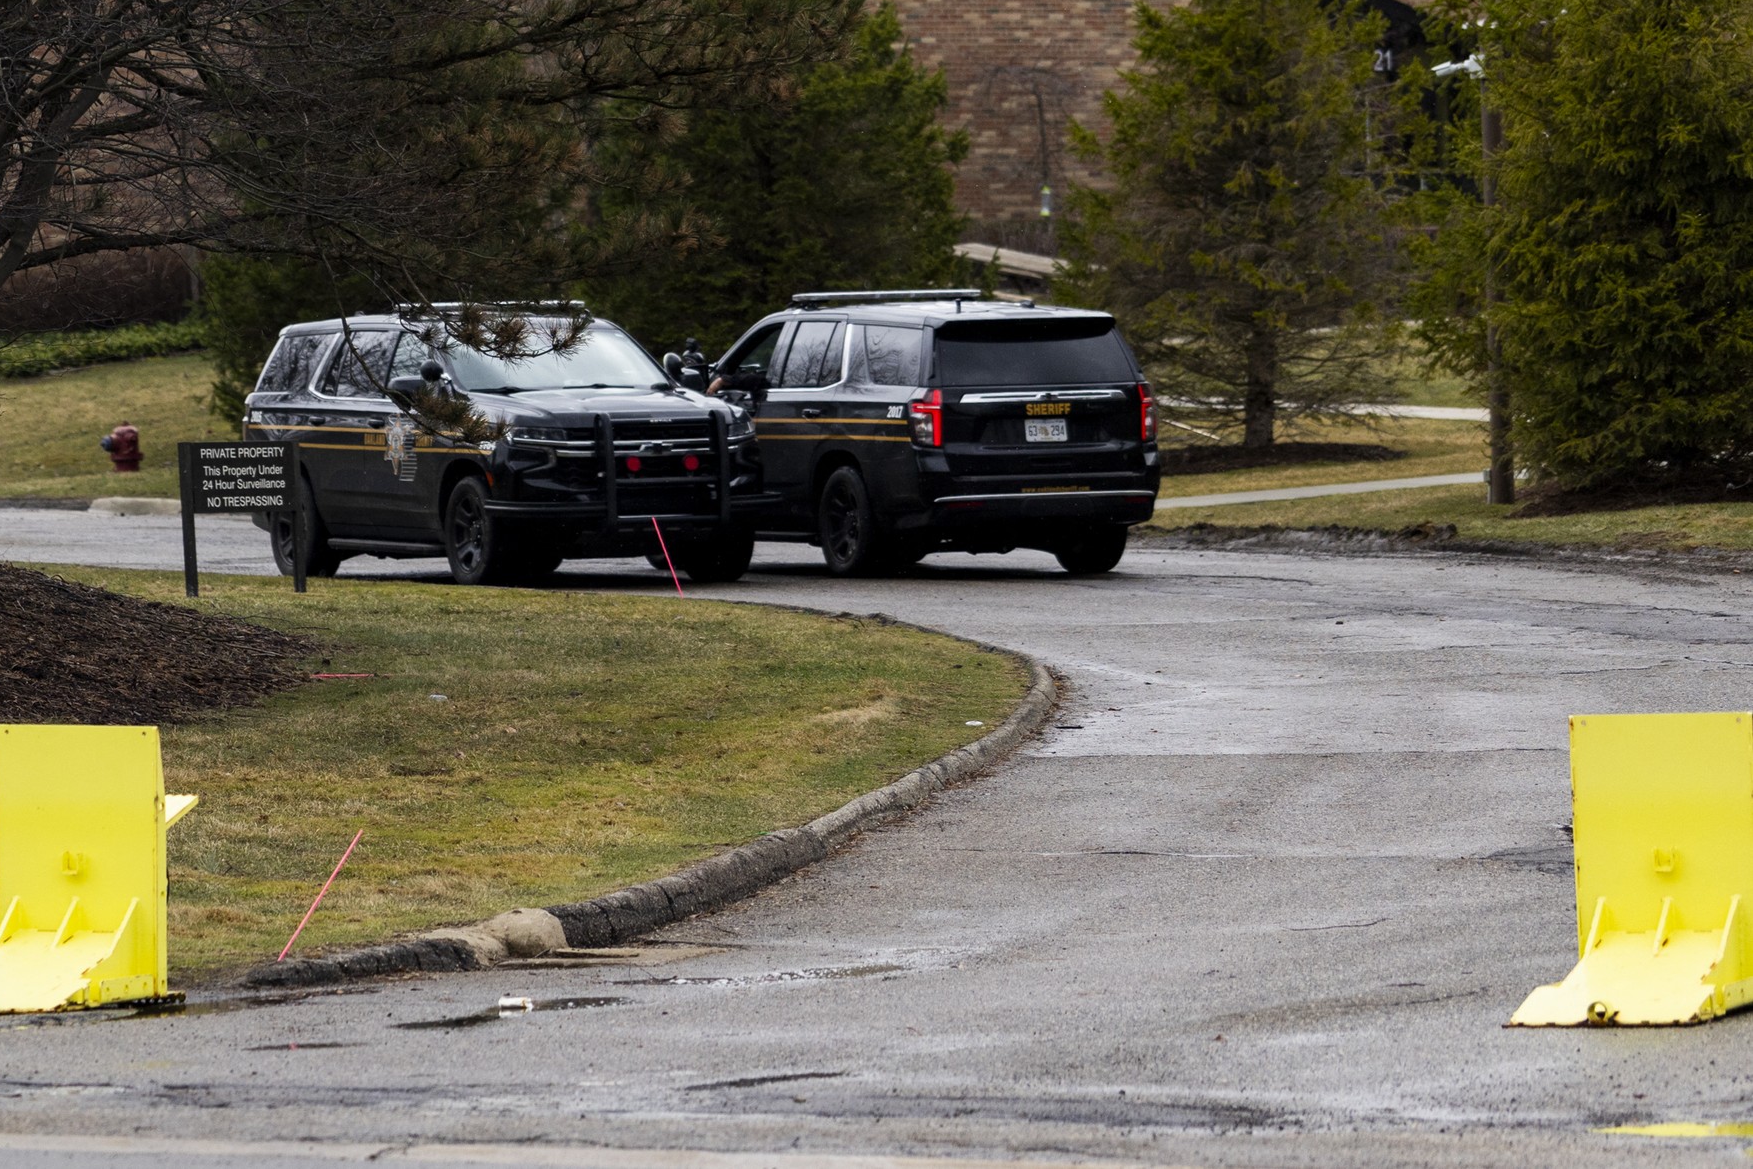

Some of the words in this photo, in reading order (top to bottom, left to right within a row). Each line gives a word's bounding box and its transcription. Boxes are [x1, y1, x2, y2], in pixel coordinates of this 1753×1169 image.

[1025, 403, 1071, 416] SHERIFF
[1027, 425, 1038, 437] 63
[1050, 424, 1065, 437] 294
[200, 448, 236, 459] PRIVATE
[237, 447, 284, 458] PROPERTY
[203, 465, 221, 476] This
[222, 465, 256, 478] Property
[258, 464, 283, 475] Under
[202, 480, 213, 490] 24
[215, 479, 235, 490] Hour
[236, 479, 286, 490] Surveillance
[207, 496, 221, 508] NO
[222, 495, 284, 507] TRESPASSING
